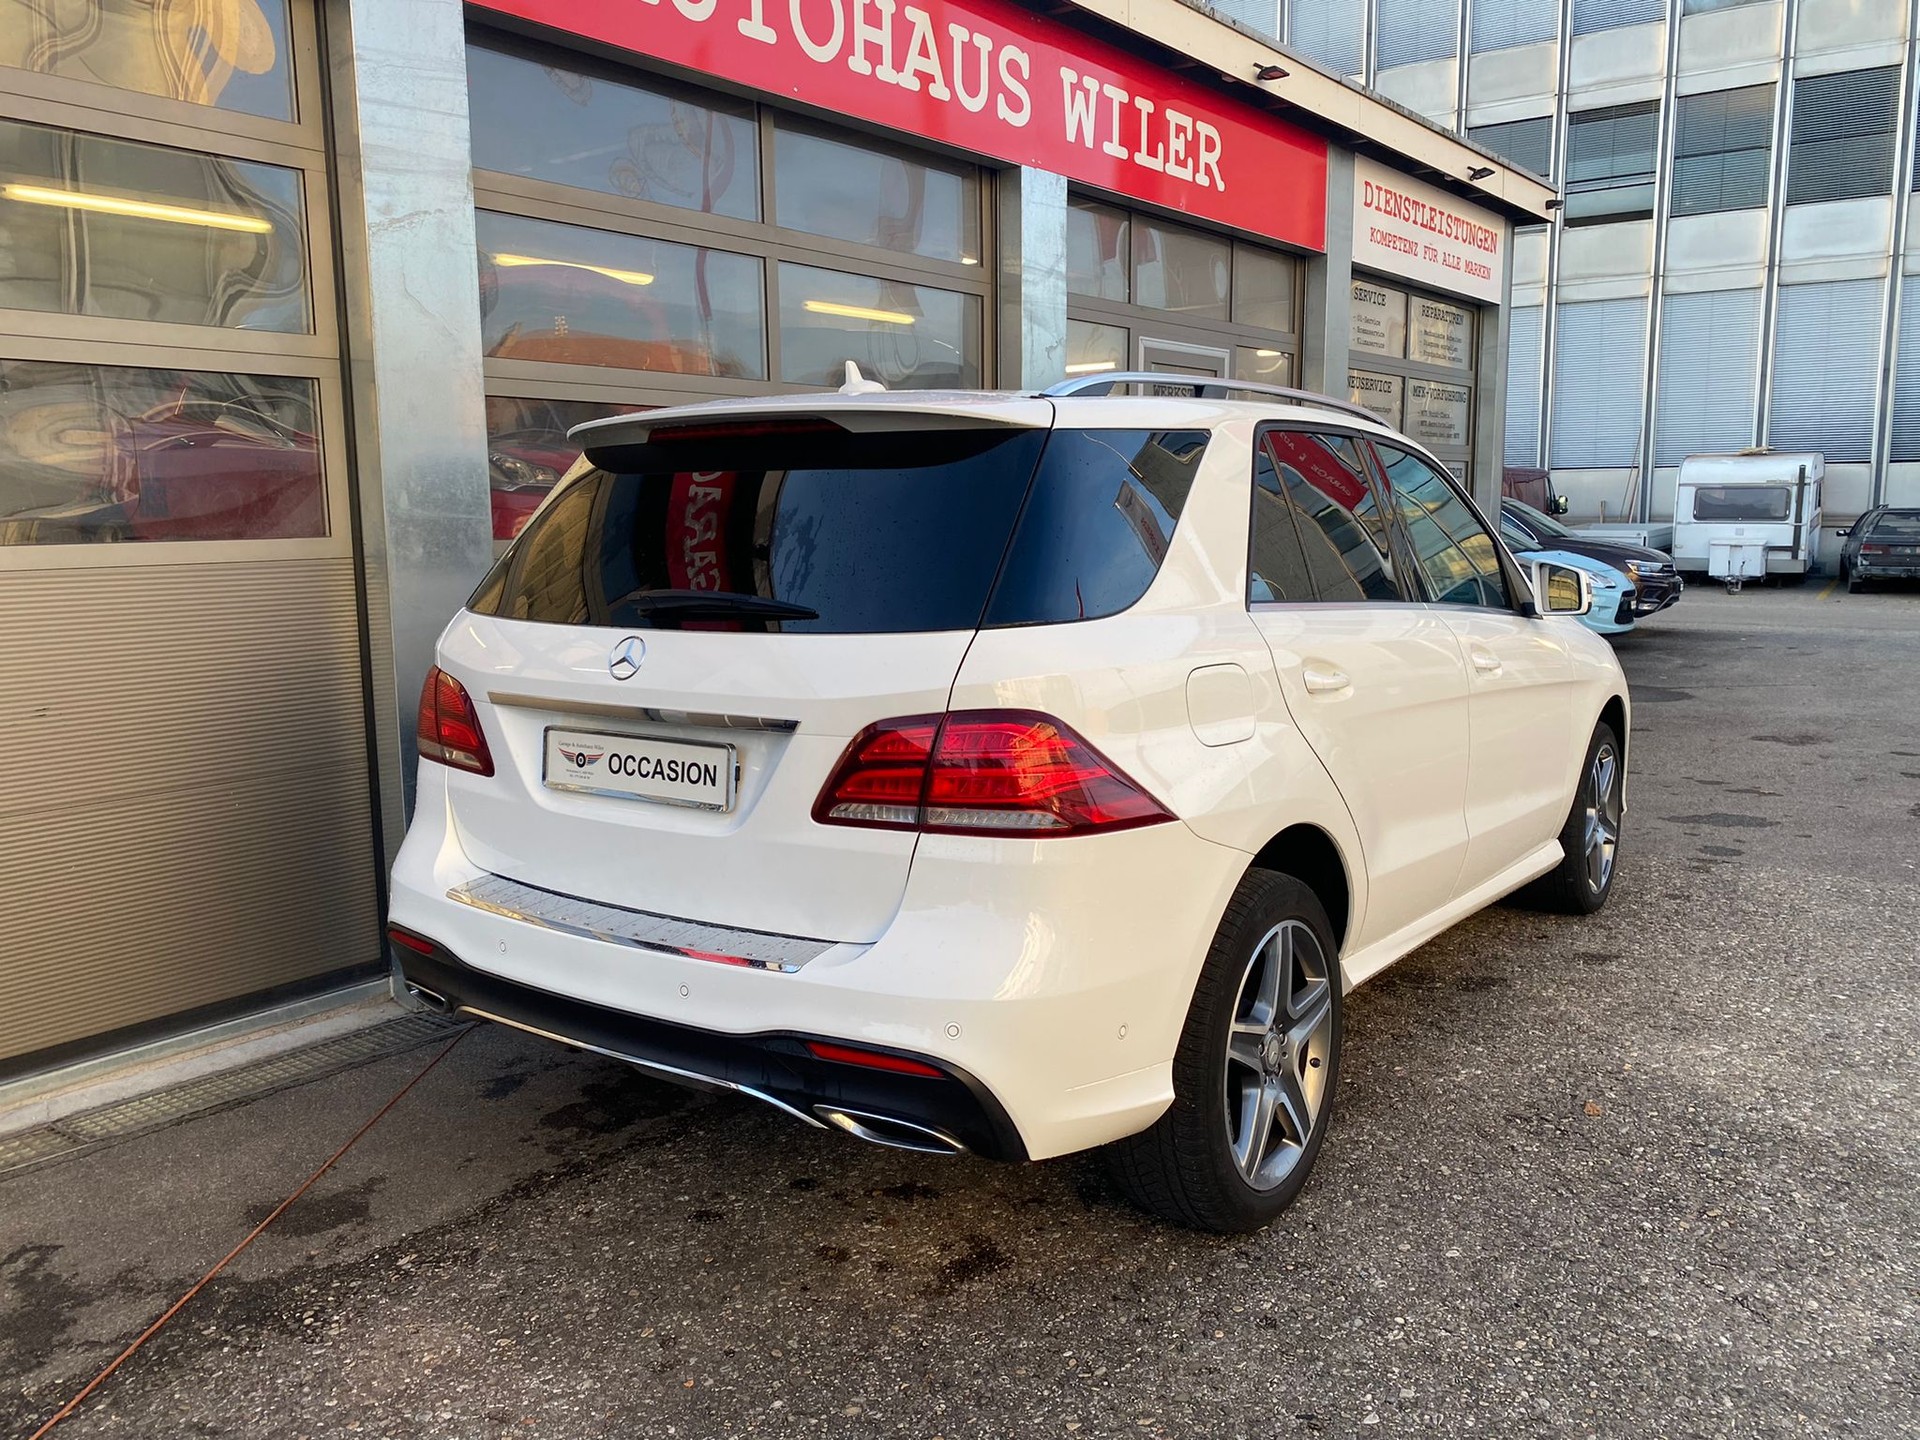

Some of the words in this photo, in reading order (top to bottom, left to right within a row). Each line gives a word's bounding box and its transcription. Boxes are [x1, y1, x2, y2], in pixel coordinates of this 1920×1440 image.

[1060, 66, 1226, 192] WILER
[1363, 180, 1499, 255] DIENSTLEISTUNGEN
[1370, 227, 1418, 257] KOMPETENZ
[1442, 252, 1462, 271] ALLE
[1464, 259, 1492, 280] MARKEN
[1353, 287, 1387, 307] SERVICE
[1421, 304, 1465, 326] REPARATUREN
[608, 753, 717, 787] OCCASION
